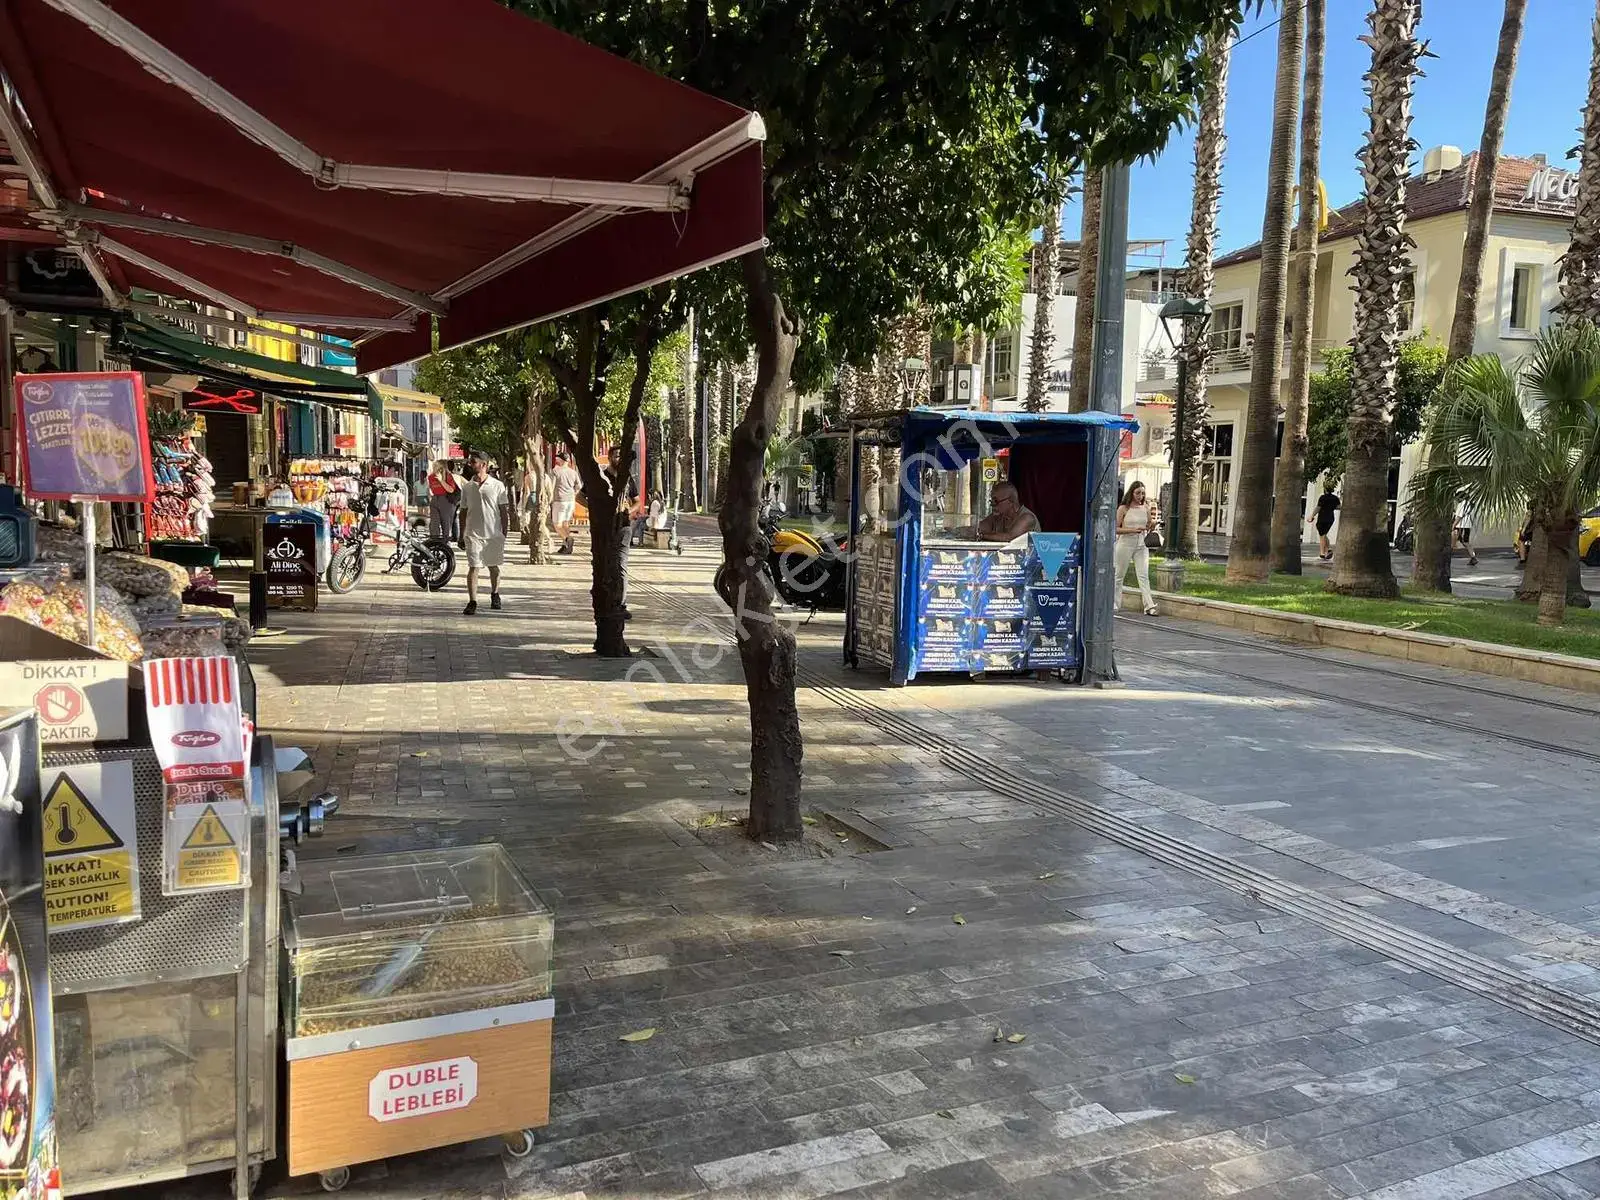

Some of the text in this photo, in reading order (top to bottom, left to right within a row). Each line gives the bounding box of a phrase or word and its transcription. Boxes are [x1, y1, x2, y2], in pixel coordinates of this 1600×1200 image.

[1526, 167, 1579, 200] McDo
[271, 561, 300, 570] Ali Dinç
[23, 664, 86, 679] DİKKAT
[40, 726, 95, 740] CAKTIR.
[45, 870, 120, 889] SEK SICAKLIK
[47, 892, 109, 909] AUTION!
[50, 904, 117, 922] TEMPERATURE
[389, 1064, 459, 1090] DUBLE
[383, 1083, 464, 1115] LEBLEBİ
